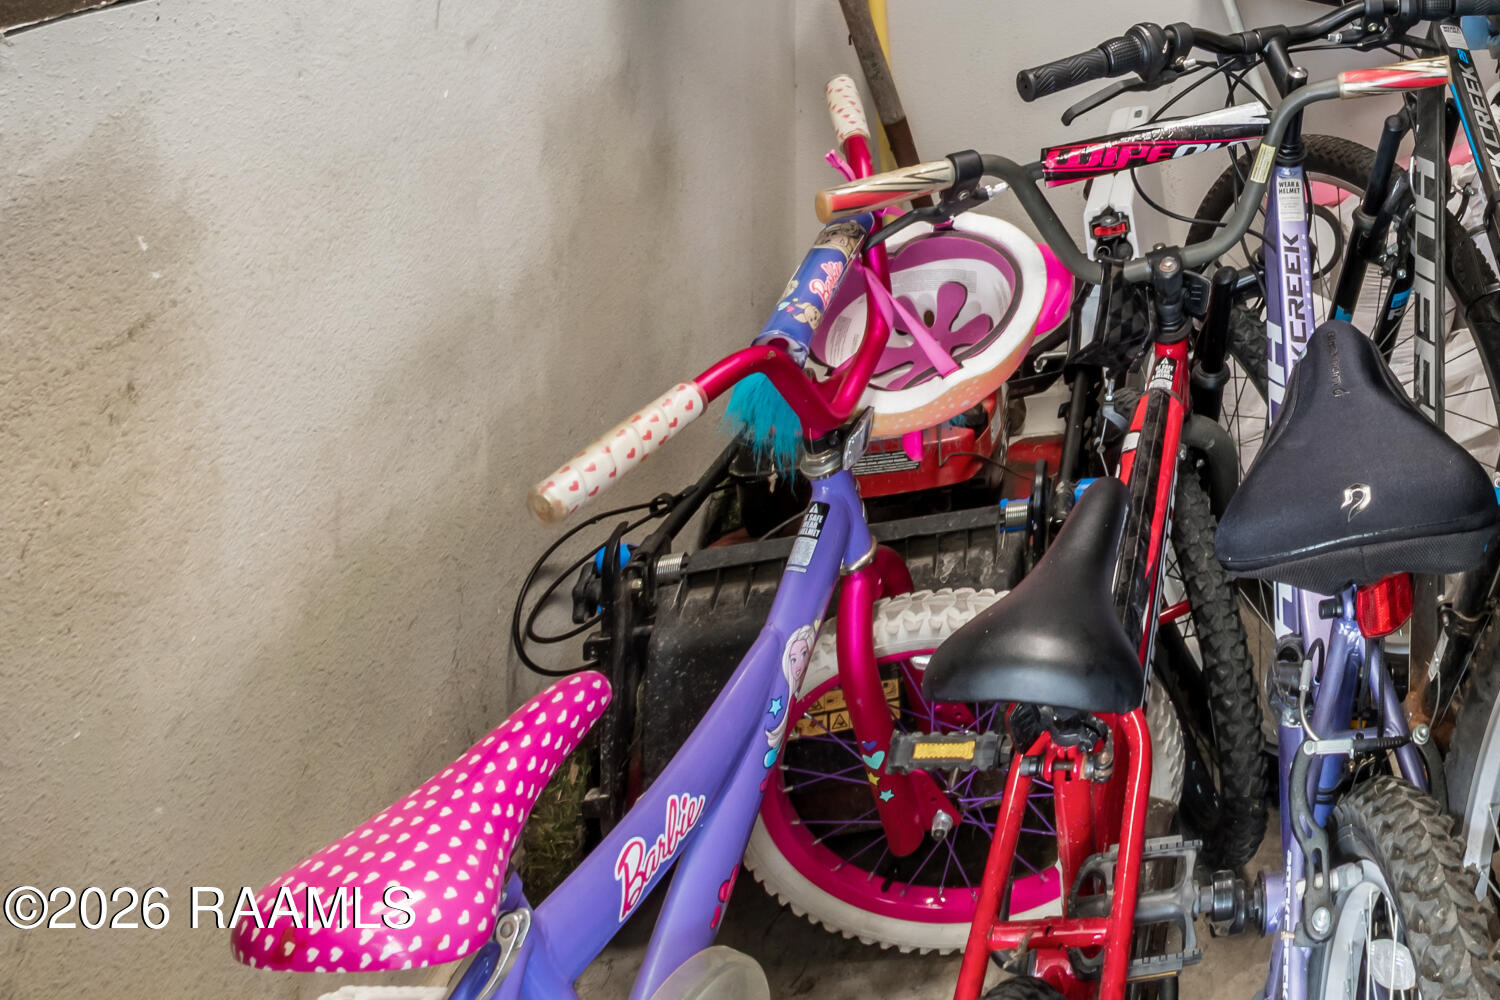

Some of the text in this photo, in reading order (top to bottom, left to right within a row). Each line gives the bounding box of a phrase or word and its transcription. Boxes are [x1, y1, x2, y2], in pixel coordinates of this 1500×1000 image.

[1278, 180, 1294, 188] WEAR
[1278, 187, 1301, 195] HELMET
[1282, 231, 1308, 345] CREEK
[809, 513, 824, 523] SAFE
[614, 792, 706, 923] Barbie
